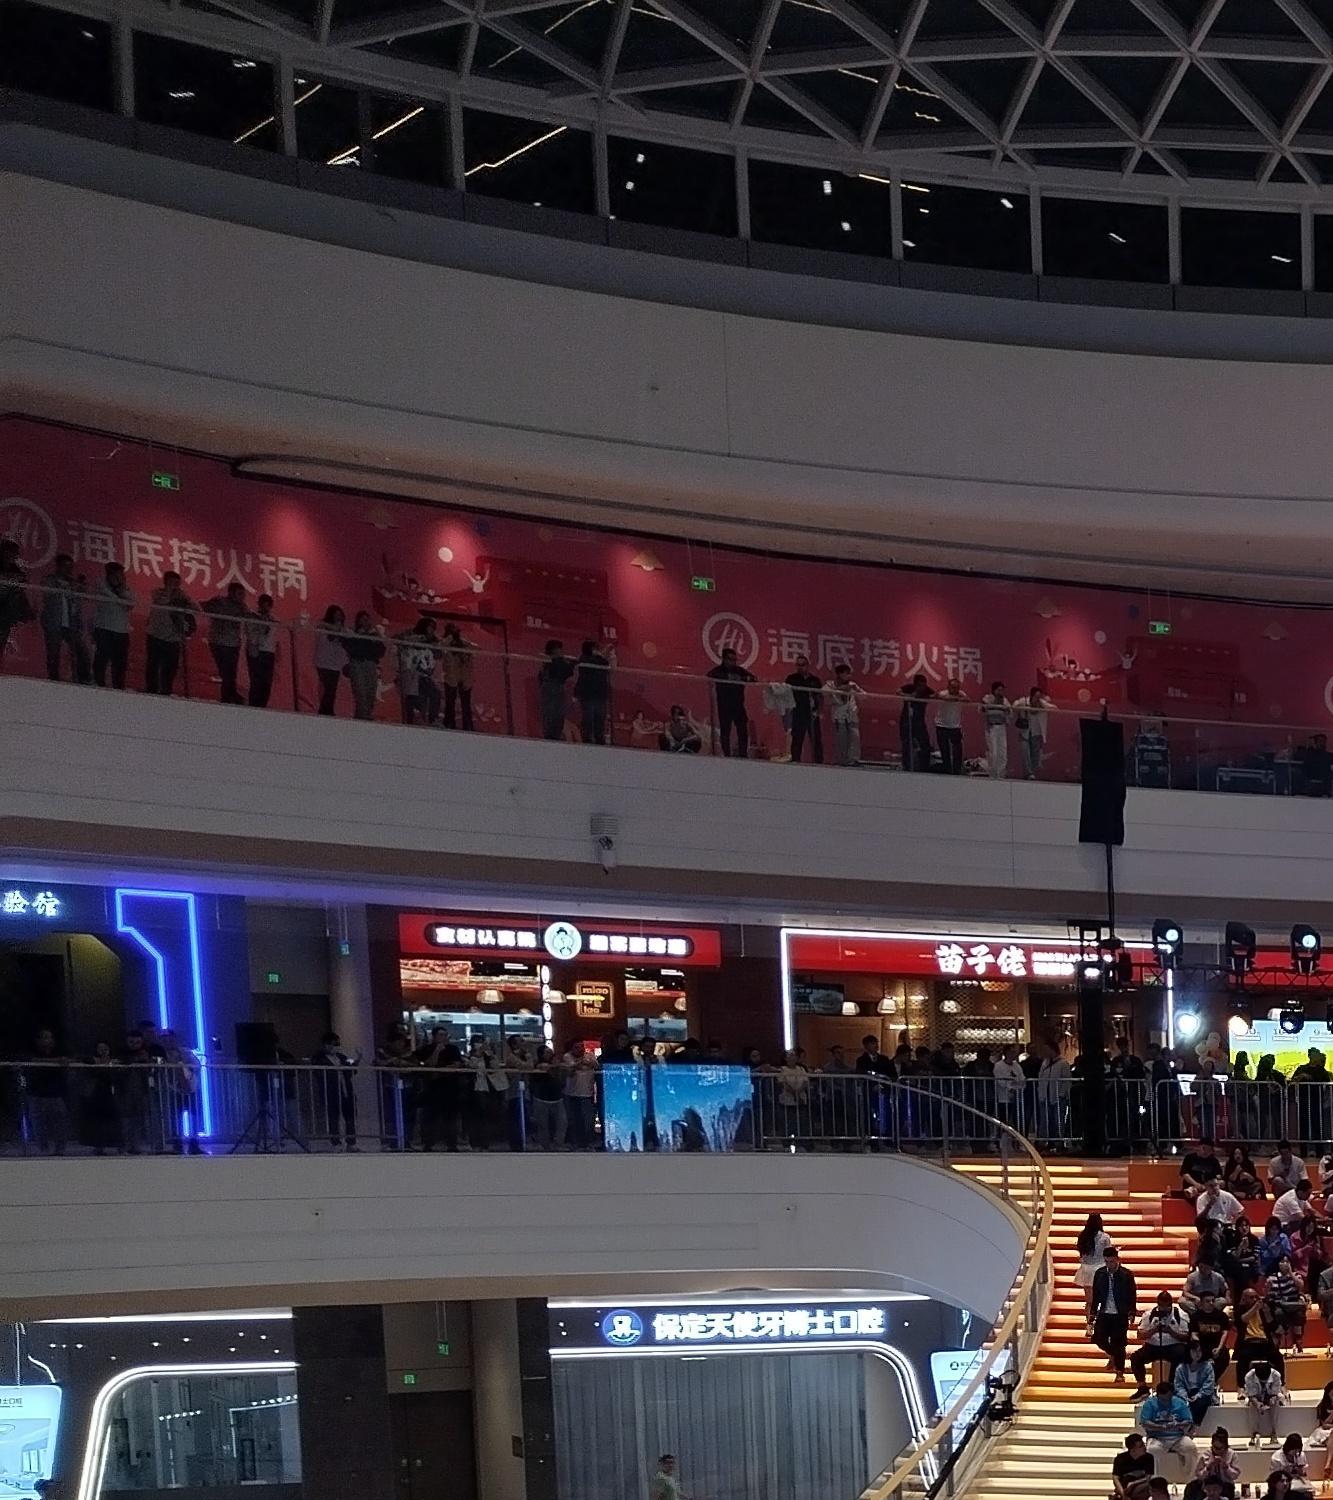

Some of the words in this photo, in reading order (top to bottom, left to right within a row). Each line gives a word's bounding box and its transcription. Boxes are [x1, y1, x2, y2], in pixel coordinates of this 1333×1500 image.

[65, 518, 308, 602] 海底捞火锅
[765, 628, 984, 686] 海底捞火锅
[935, 943, 1028, 977] 苗子佬
